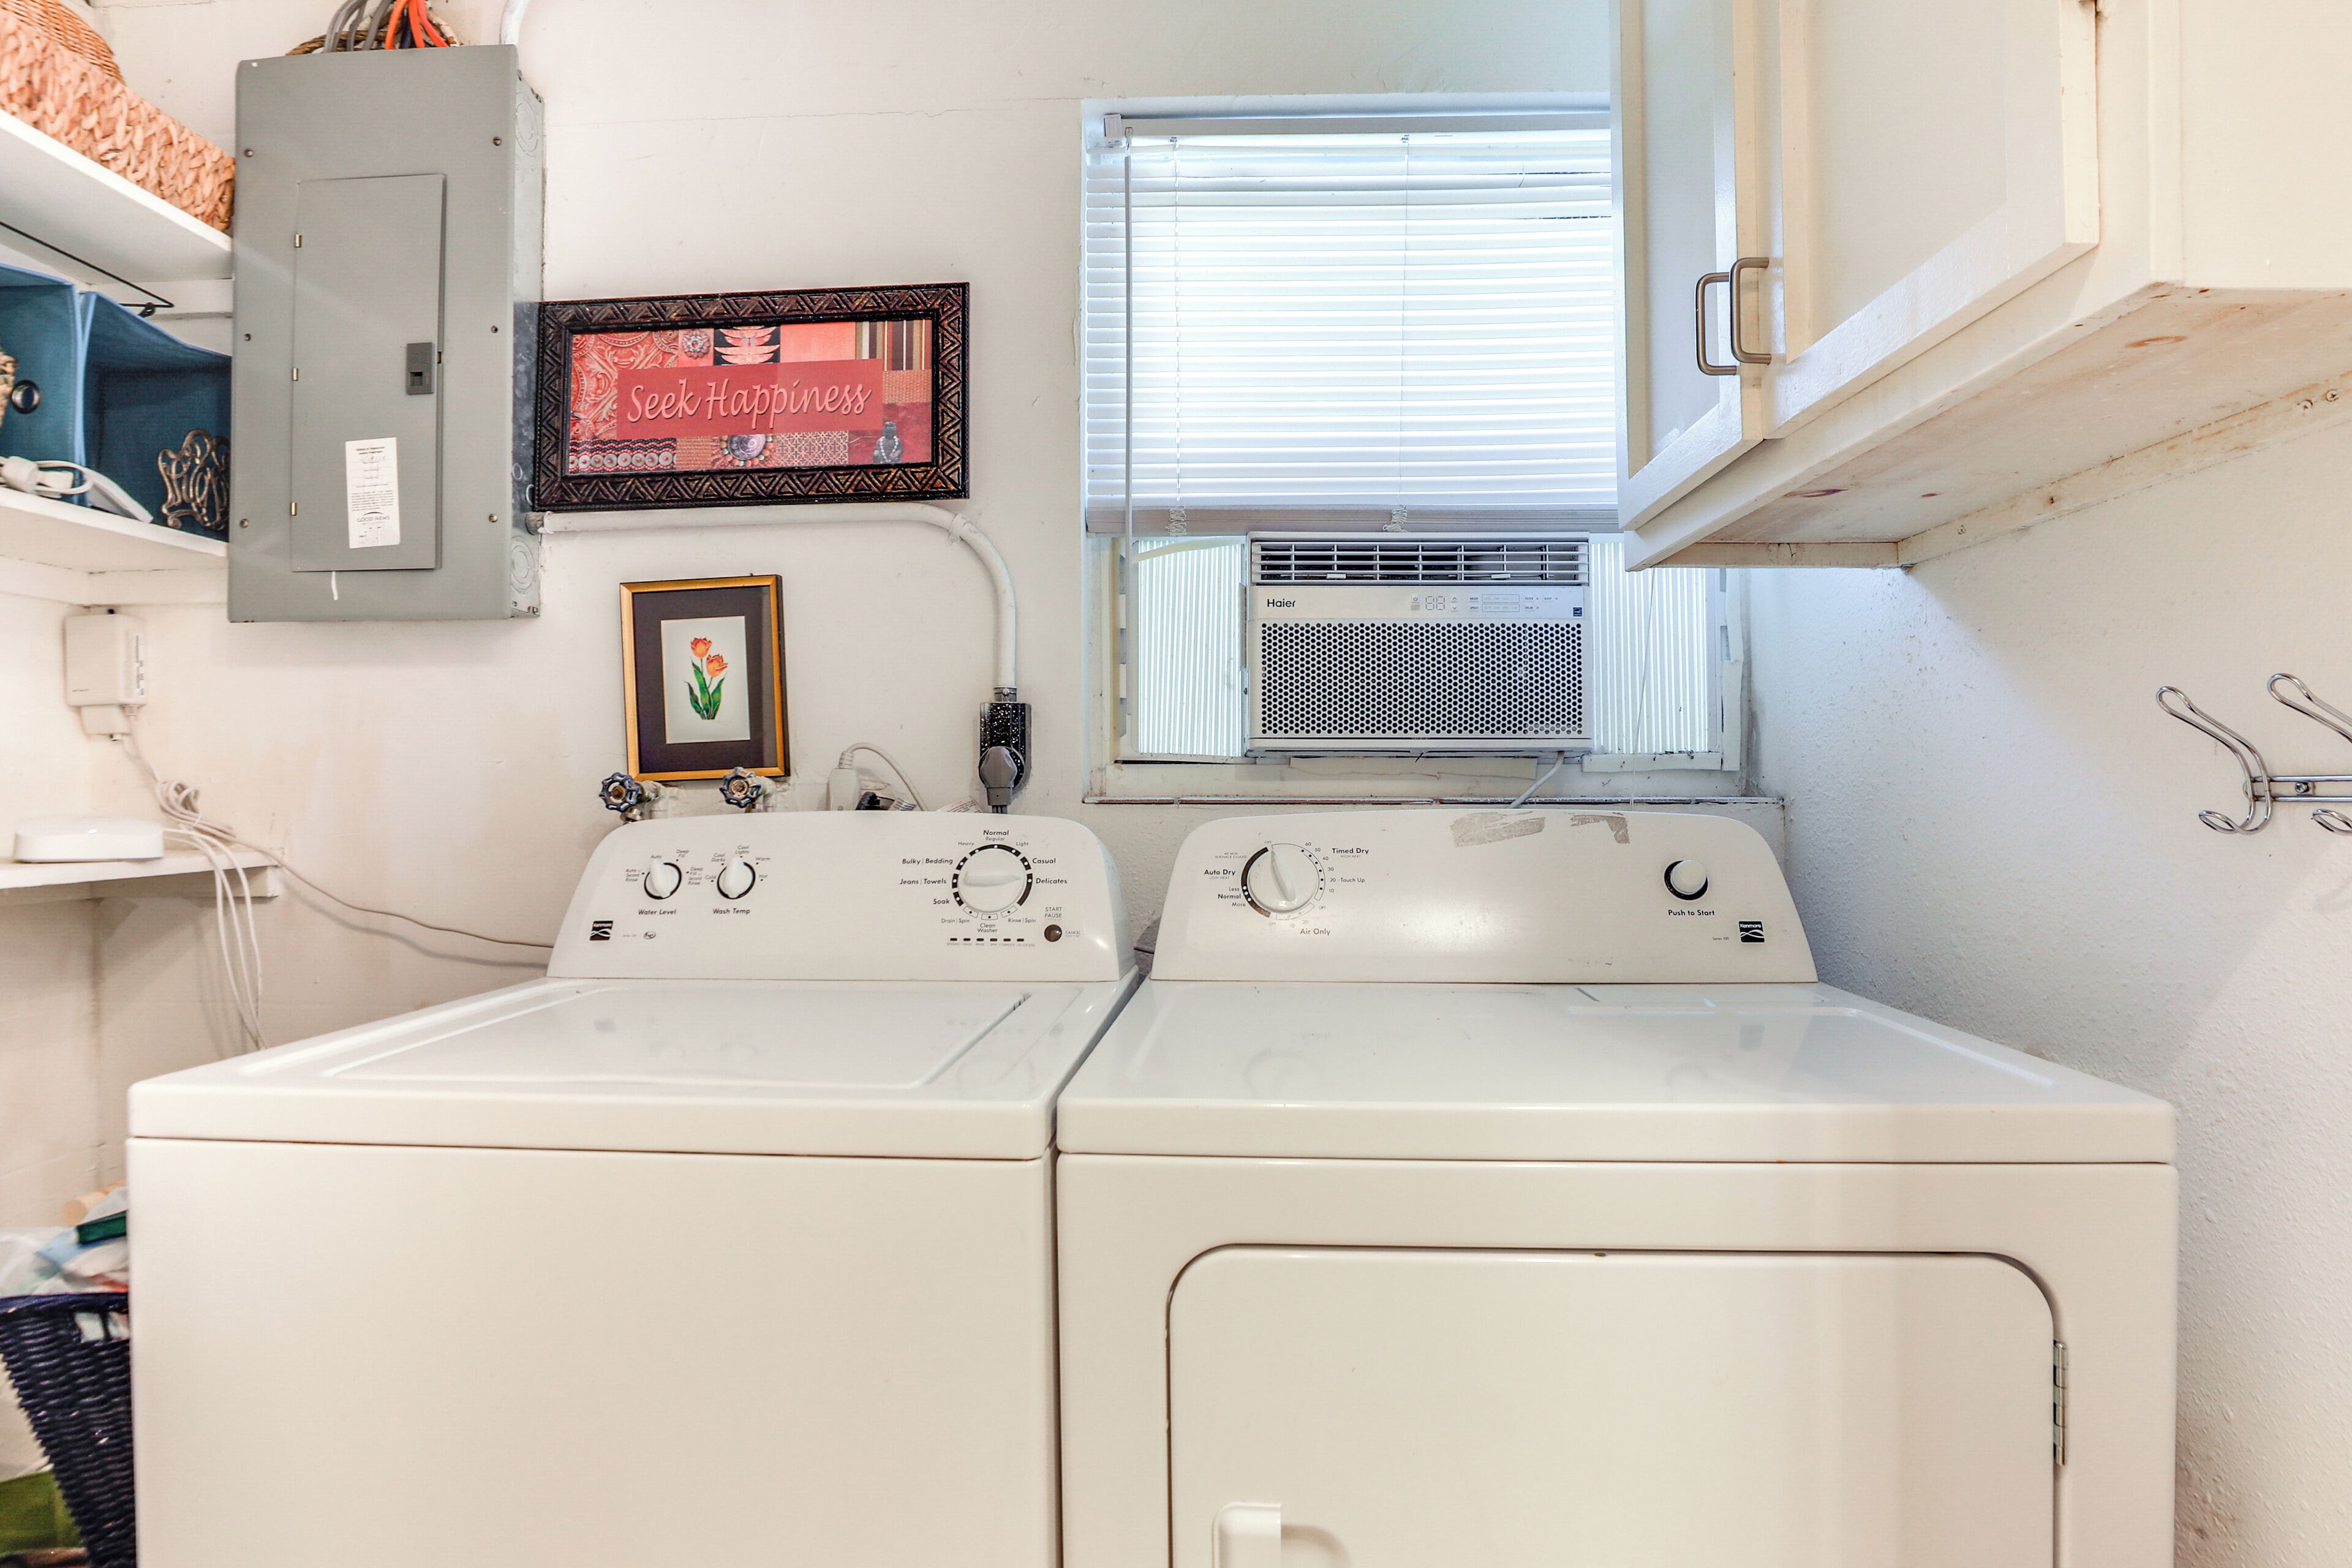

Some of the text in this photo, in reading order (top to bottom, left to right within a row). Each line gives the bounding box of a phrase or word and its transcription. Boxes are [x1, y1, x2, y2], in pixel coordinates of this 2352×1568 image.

[627, 378, 872, 429] Seek Happiness
[1267, 598, 1295, 607] Haier
